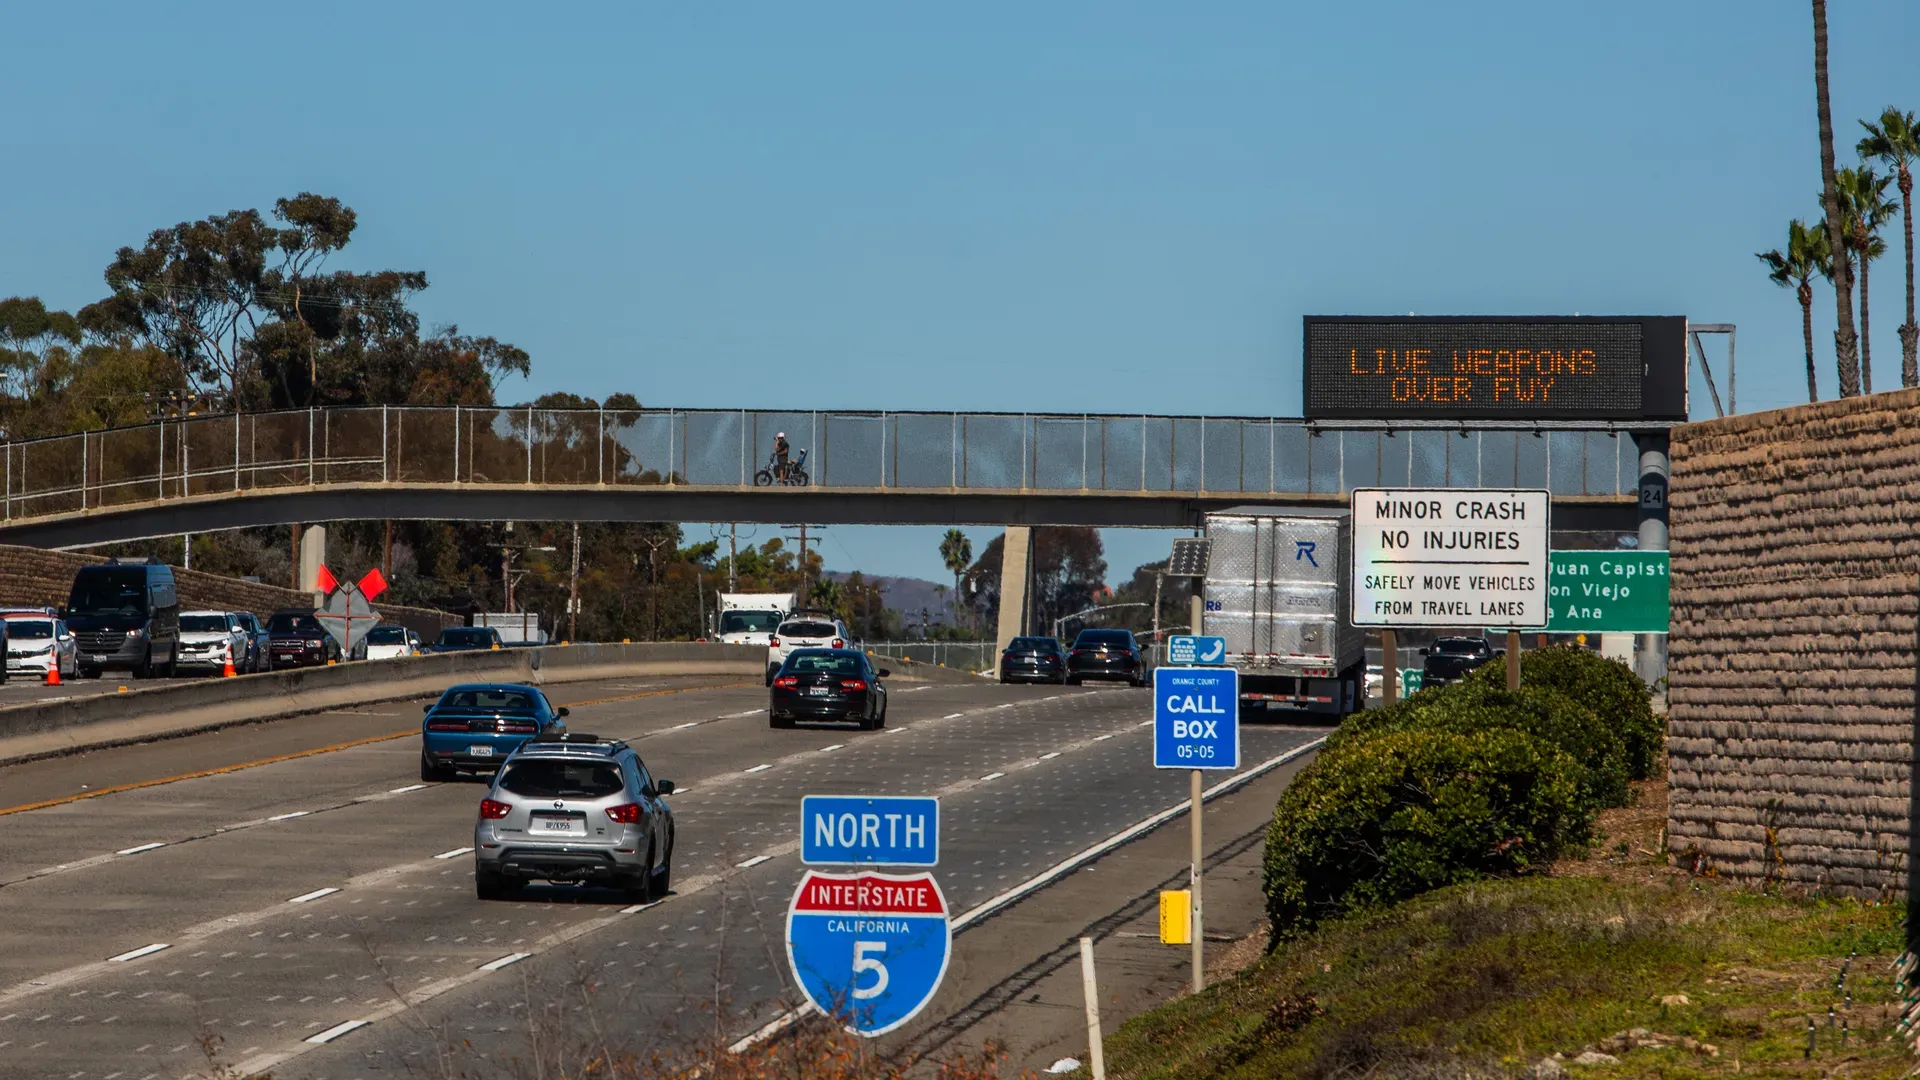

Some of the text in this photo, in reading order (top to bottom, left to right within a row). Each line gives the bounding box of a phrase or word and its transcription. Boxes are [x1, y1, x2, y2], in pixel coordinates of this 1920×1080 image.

[1351, 348, 1598, 376] LIVE WEAPONS
[1391, 377, 1556, 402] OVER FWY
[1643, 489, 1662, 504] 24
[1376, 500, 1525, 520] MINOR CRASH
[1381, 530, 1520, 550] NO INJURIES
[1600, 561, 1665, 579] Capist
[1365, 575, 1535, 591] SAFELY MOVE VEHICLES
[1581, 583, 1630, 601] Viejo
[1375, 601, 1525, 616] FROM TRAVEL LANES
[1566, 604, 1603, 619] Ana
[1197, 678, 1220, 686] COUNTY
[1166, 695, 1226, 714] CALL
[1173, 720, 1218, 739] BOX
[1177, 745, 1215, 759] 05-05
[815, 813, 925, 848] NORTH
[810, 885, 928, 907] INTERSTATE
[827, 919, 910, 934] CALIFORNIA
[851, 941, 889, 1000] 5
